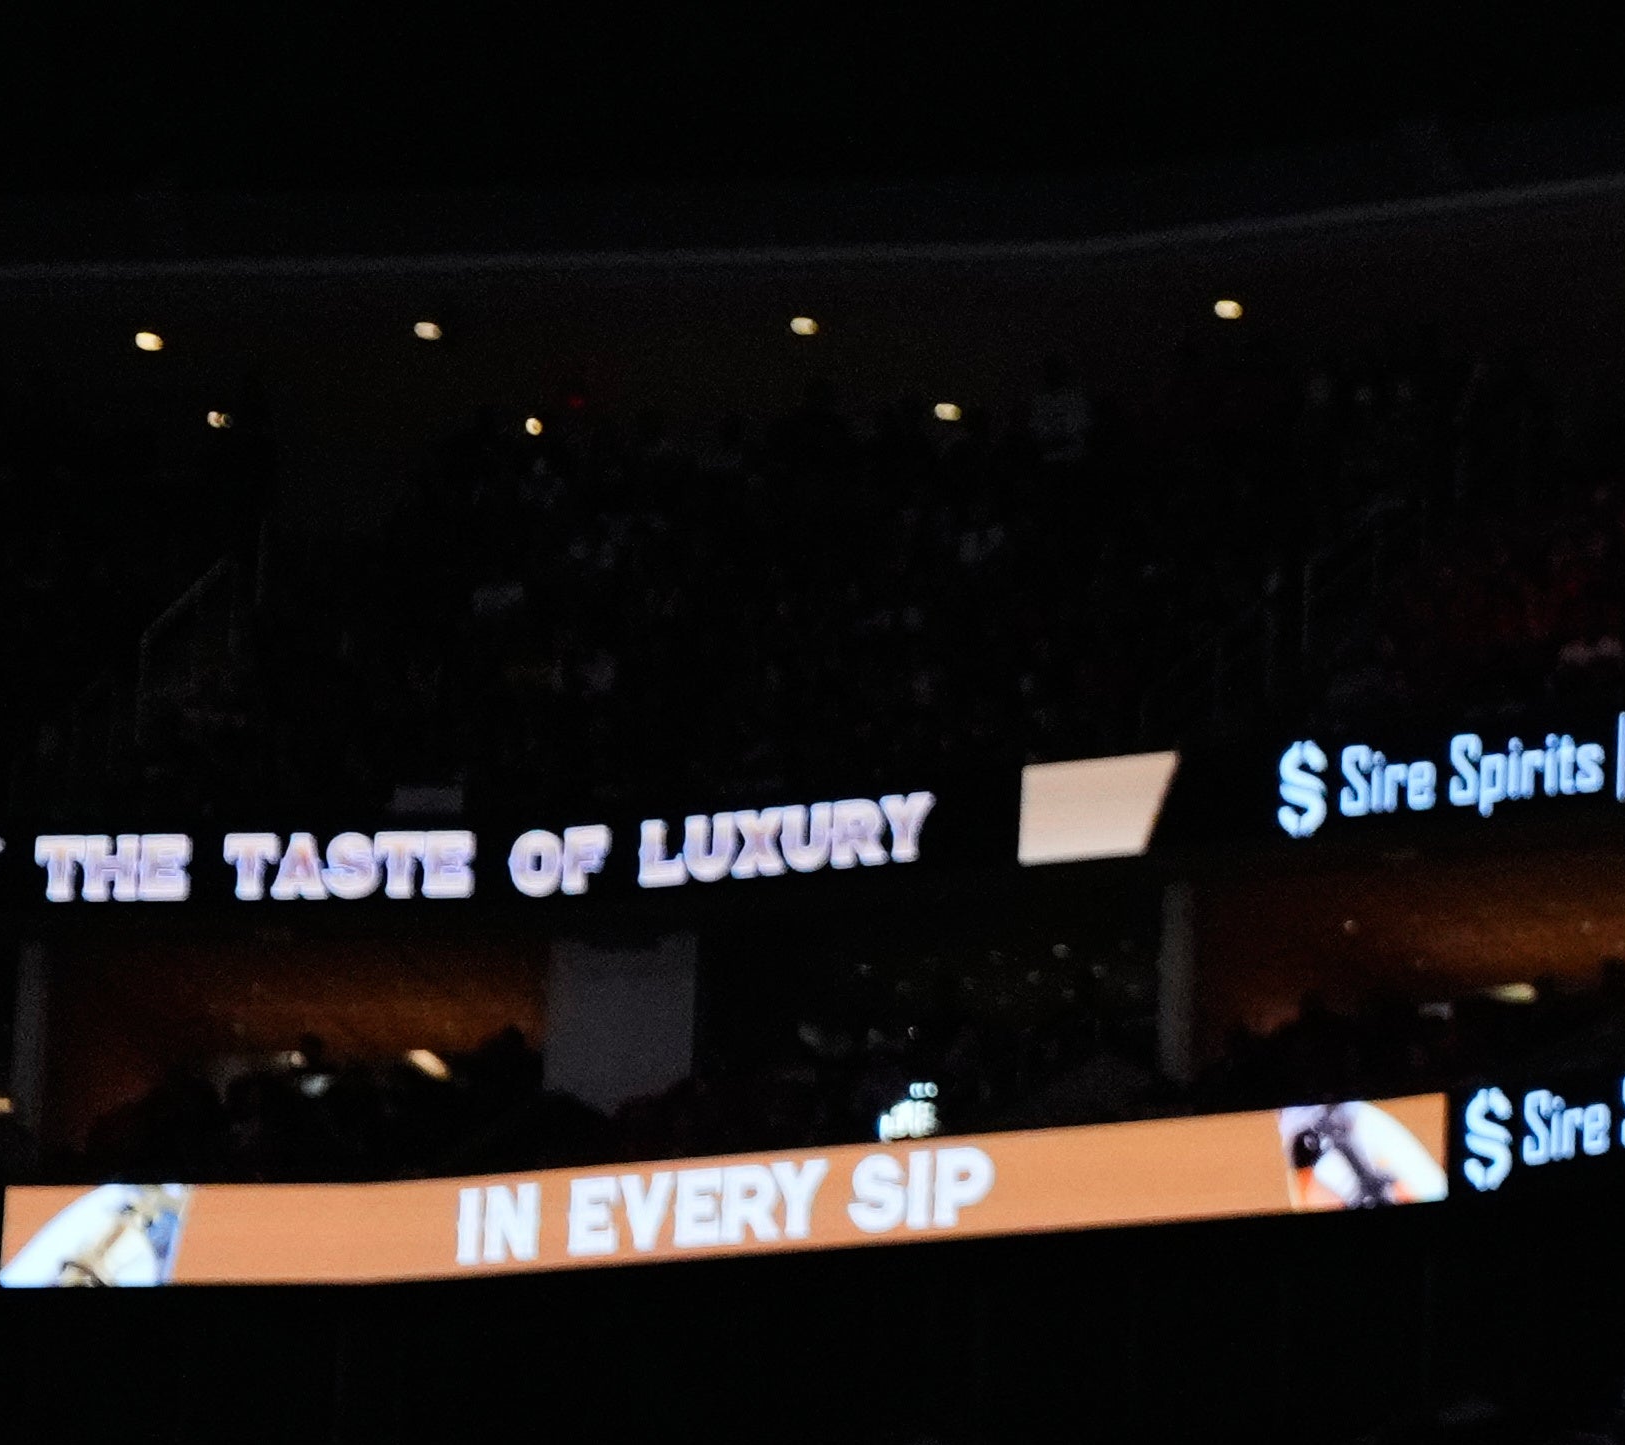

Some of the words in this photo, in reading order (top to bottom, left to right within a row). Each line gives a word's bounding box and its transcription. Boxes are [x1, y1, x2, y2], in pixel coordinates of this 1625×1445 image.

[1339, 745, 1436, 816] Sire
[1449, 733, 1605, 817] Spirits
[35, 834, 192, 902] THE
[223, 830, 475, 900] TASTE
[508, 825, 611, 897] OF
[638, 792, 934, 888] LUXURY
[1522, 1089, 1611, 1165] Sire
[455, 1182, 542, 1267] IN
[566, 1156, 831, 1258] EVERY
[846, 1145, 995, 1233] SIP
